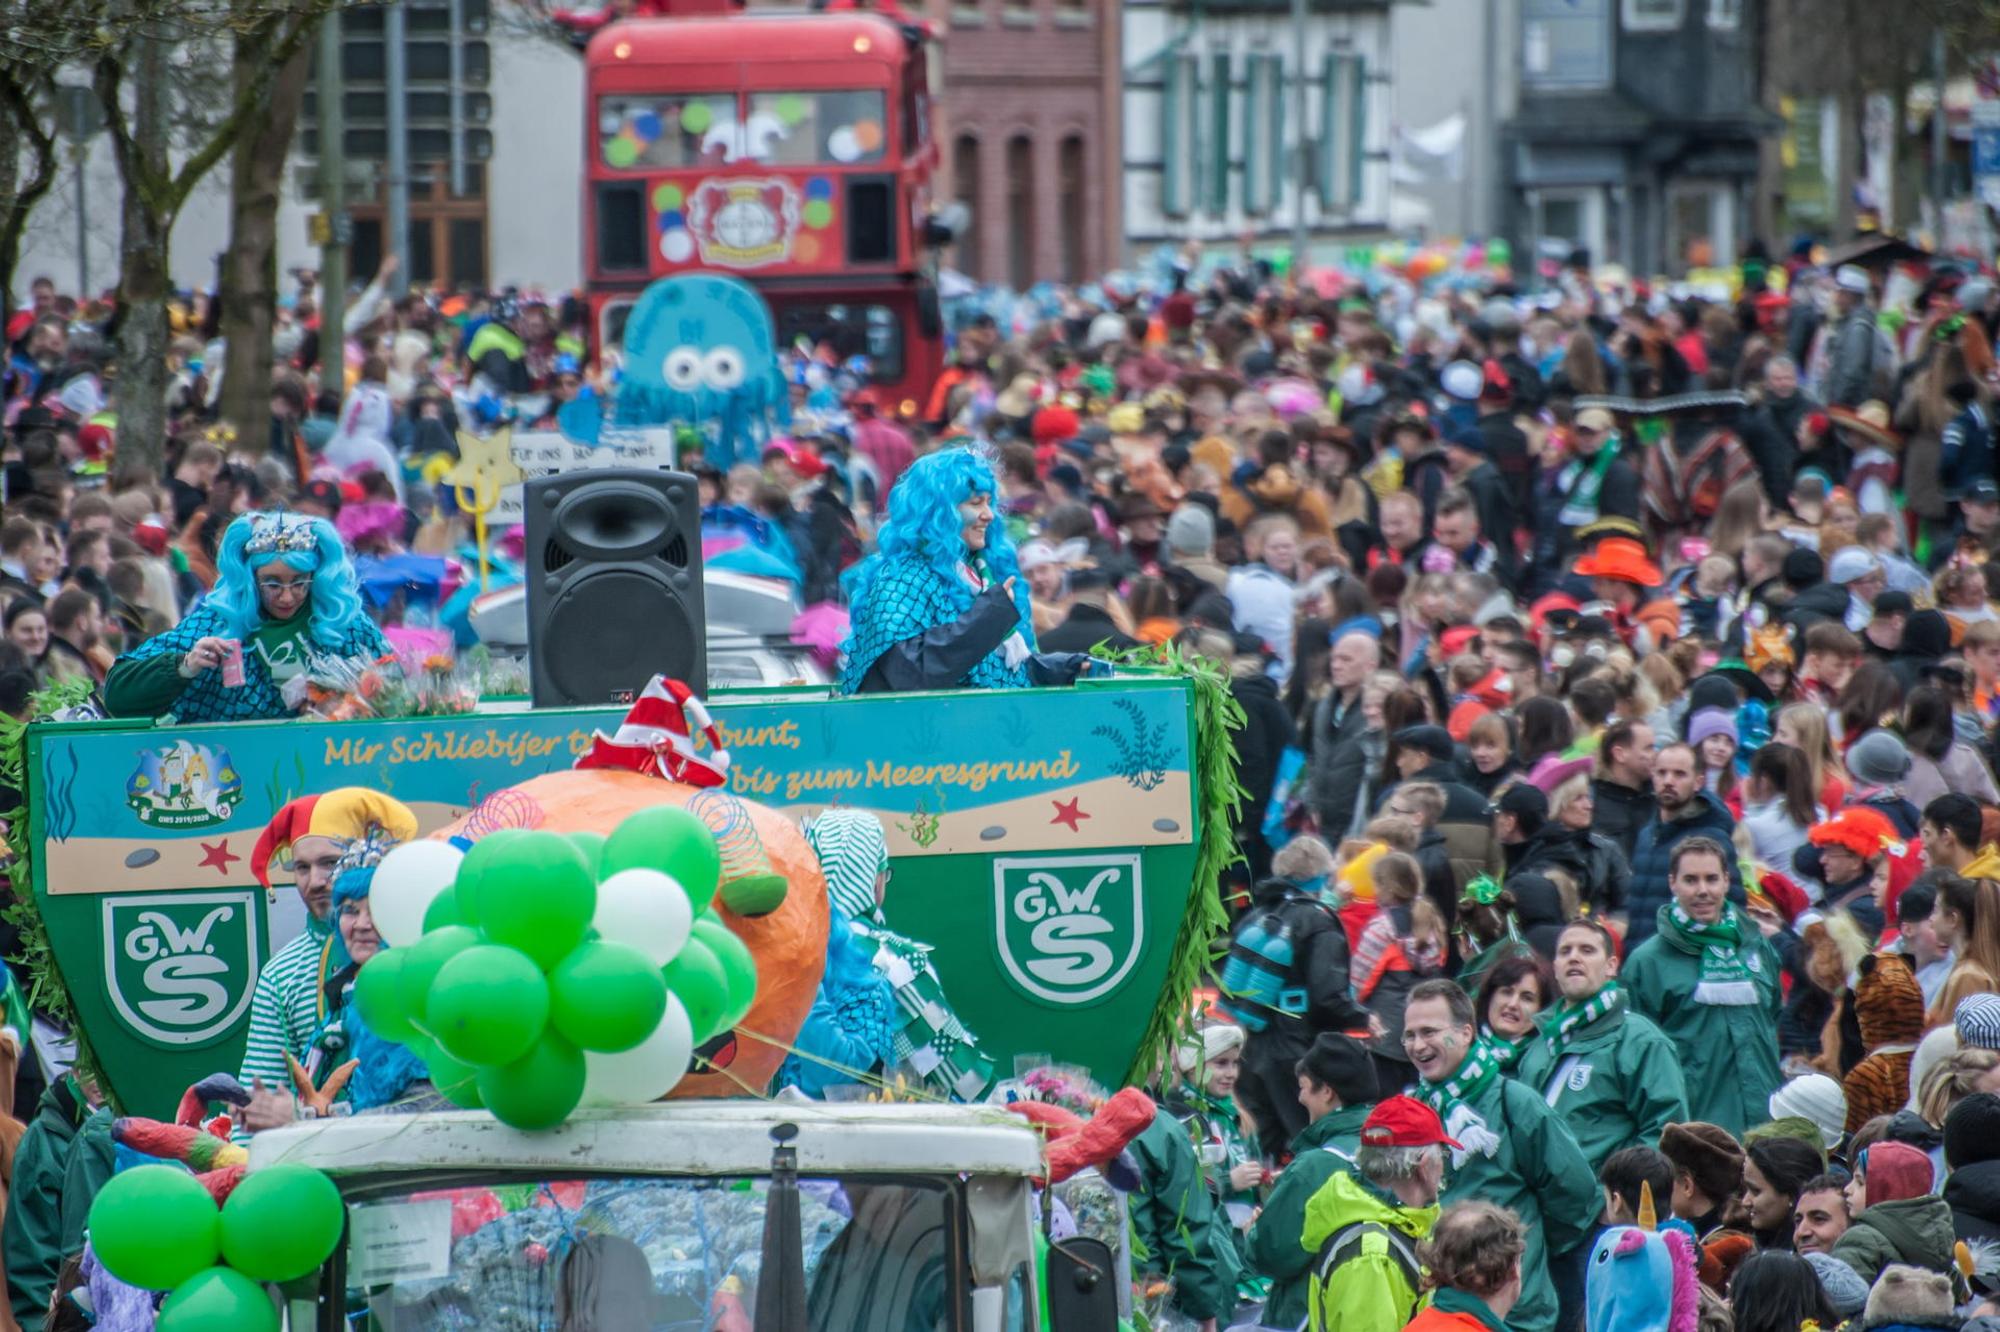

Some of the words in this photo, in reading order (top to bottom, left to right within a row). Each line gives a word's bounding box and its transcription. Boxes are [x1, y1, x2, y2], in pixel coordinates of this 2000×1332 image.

[324, 737, 384, 766] Mir
[388, 729, 562, 766] Schliebijer
[715, 720, 800, 749] bunt,
[731, 764, 782, 793] bis
[786, 767, 861, 799] zum
[865, 750, 1080, 792] Meeresgrund
[1026, 914, 1114, 985] S
[138, 954, 230, 1025] S
